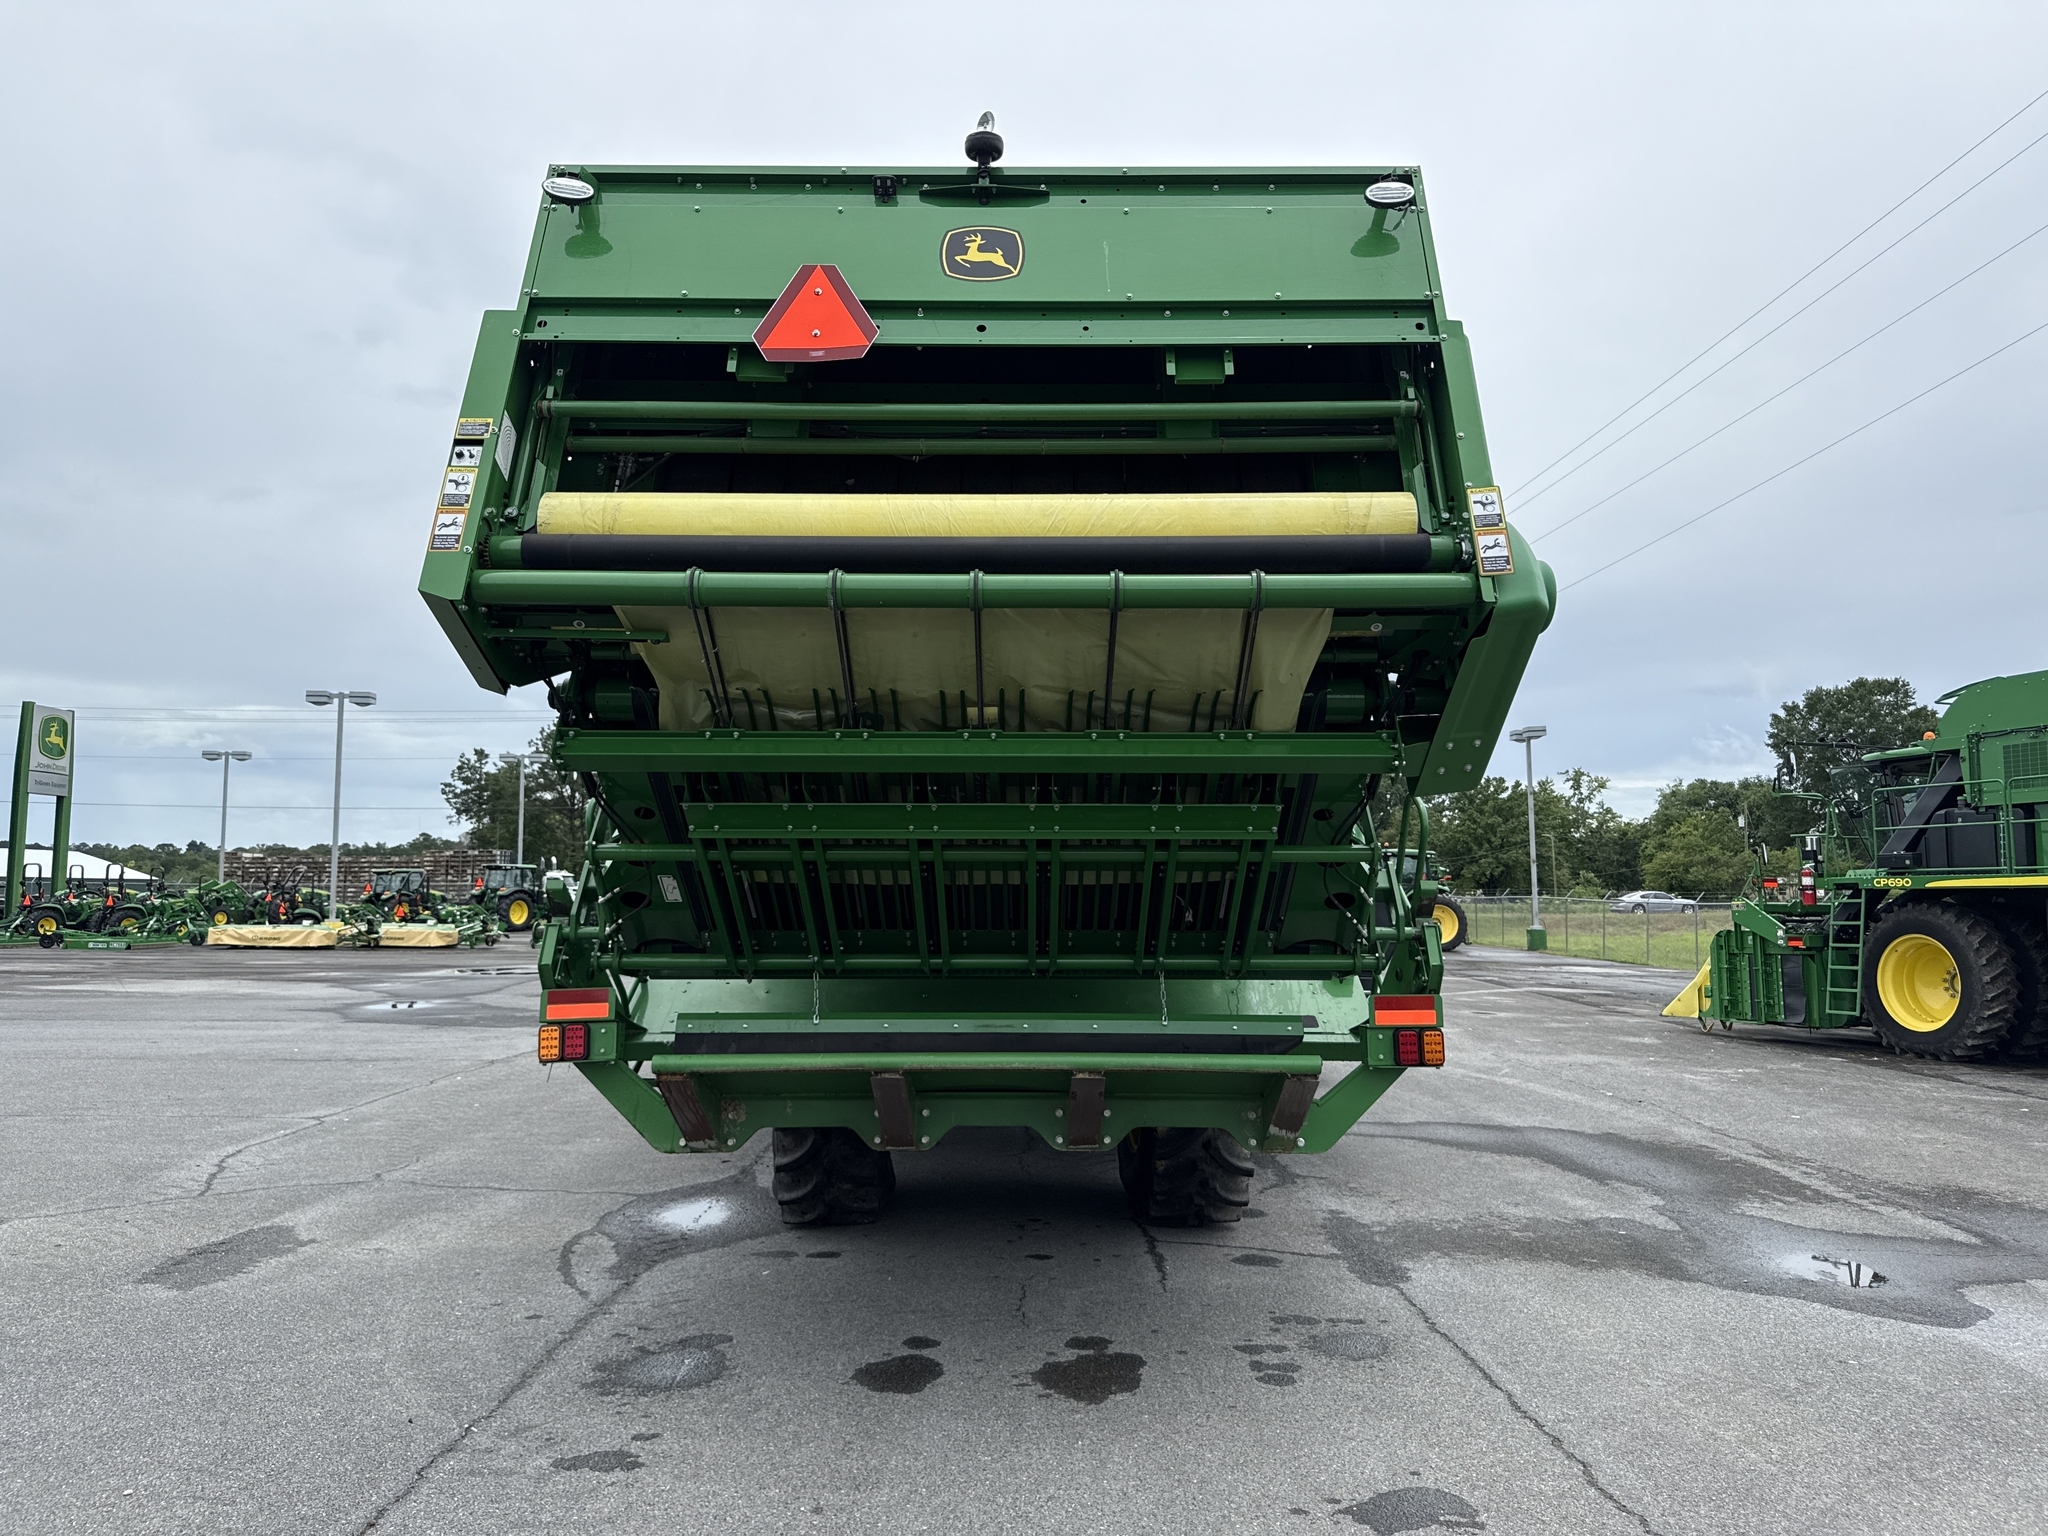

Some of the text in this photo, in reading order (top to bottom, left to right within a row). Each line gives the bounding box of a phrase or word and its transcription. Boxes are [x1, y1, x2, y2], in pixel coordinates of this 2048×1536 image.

[35, 761, 67, 772] JOHN DEERE
[1873, 878, 1912, 887] CP690
